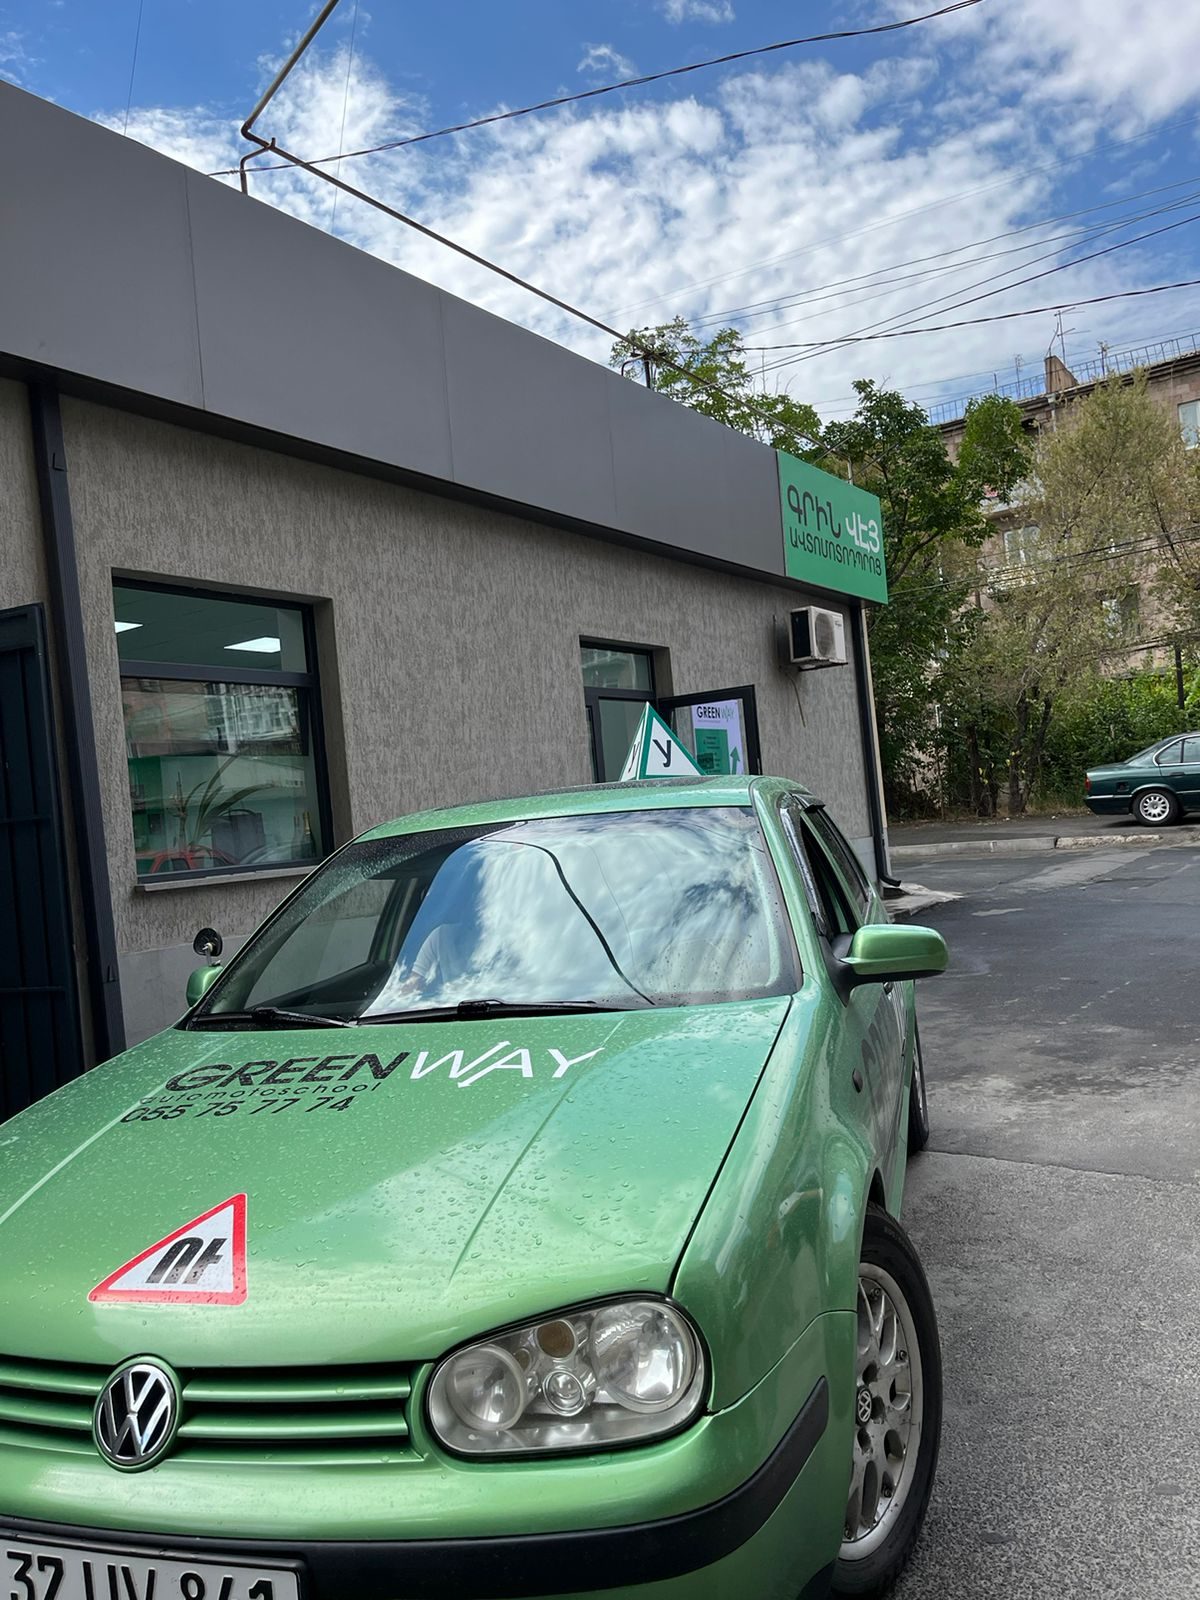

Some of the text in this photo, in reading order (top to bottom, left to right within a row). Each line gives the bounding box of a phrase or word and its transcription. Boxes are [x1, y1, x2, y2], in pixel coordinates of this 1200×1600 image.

[140, 1082, 381, 1104] automotoschool
[120, 1096, 356, 1123] 055 75 77 74
[6, 1550, 64, 1600] 37
